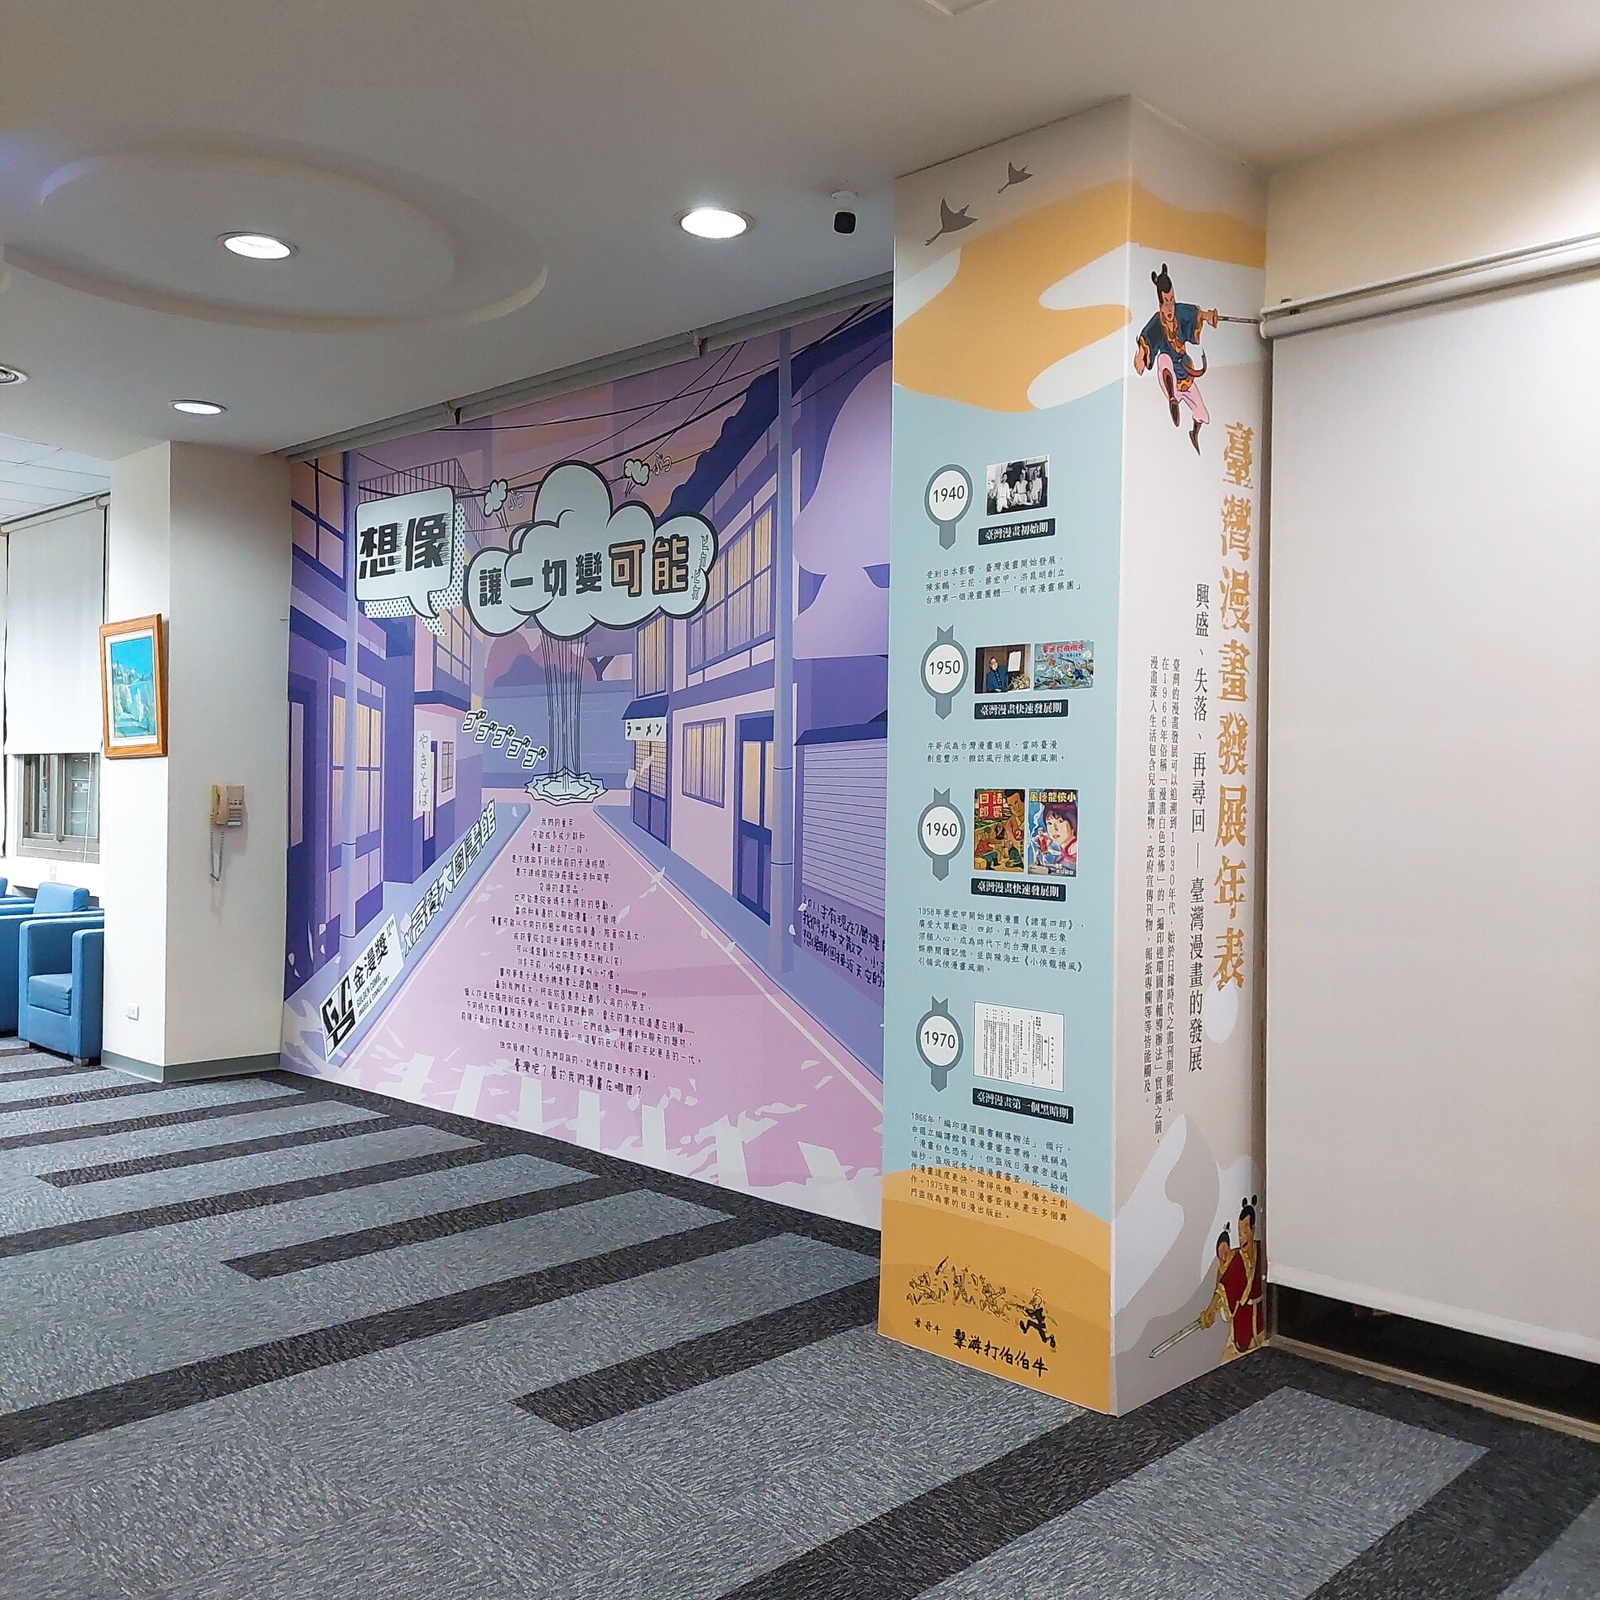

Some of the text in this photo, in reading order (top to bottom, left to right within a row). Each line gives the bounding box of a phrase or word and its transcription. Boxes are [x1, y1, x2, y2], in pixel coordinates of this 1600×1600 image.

[933, 485, 965, 503] 1940
[359, 513, 451, 579] 想像
[479, 533, 690, 607] 讓一切變可能
[929, 660, 960, 675] 1950
[627, 722, 663, 737] ラーメン
[1213, 421, 1254, 991] 臺灣漫畫發展年表
[463, 710, 547, 768] ゴゴゴゴゴ
[419, 733, 430, 807] やきそば
[926, 822, 957, 837] 1960
[352, 932, 388, 993] 金漫獎
[924, 1031, 956, 1049] 1970
